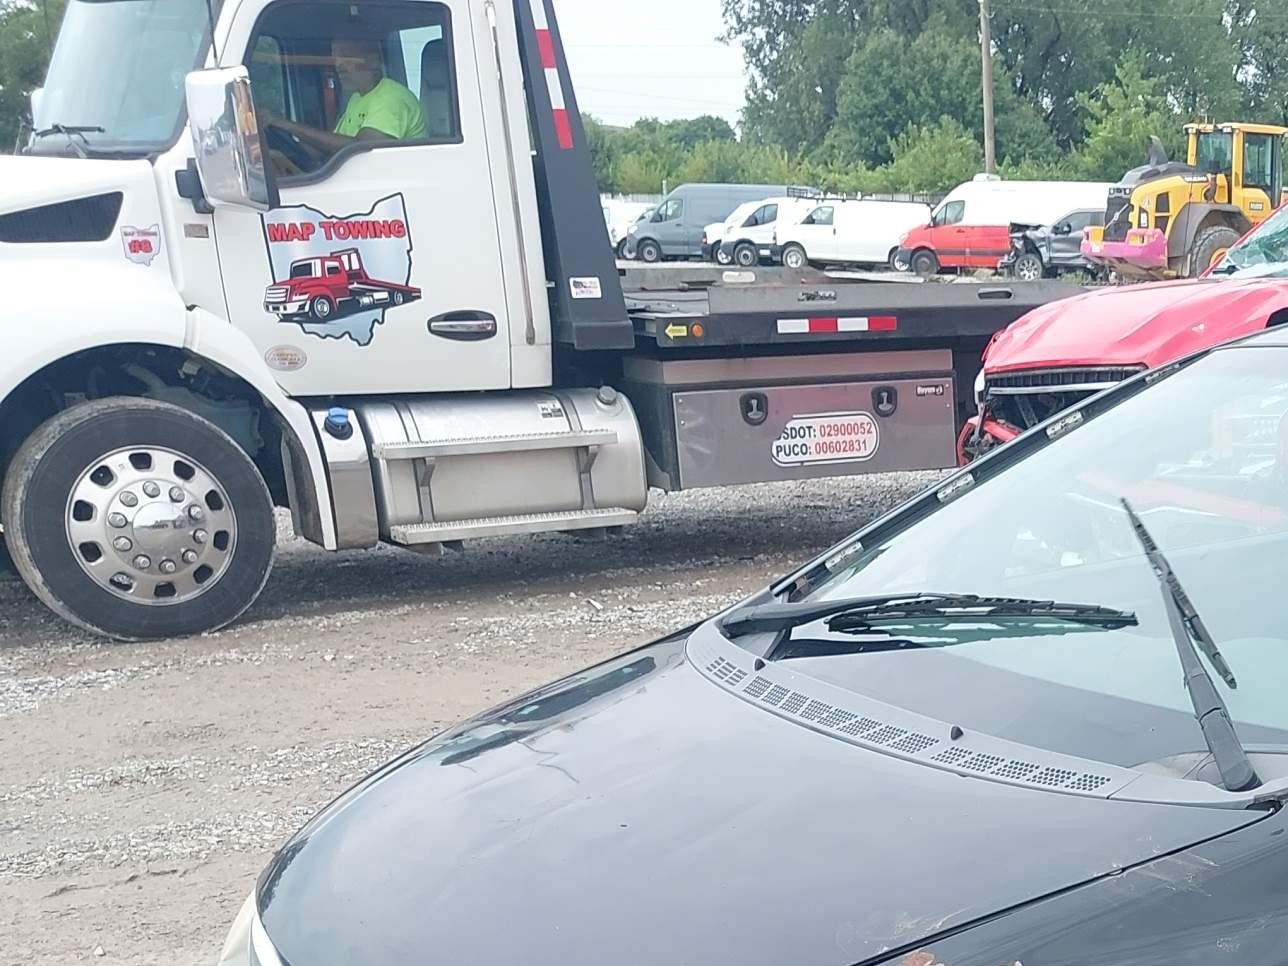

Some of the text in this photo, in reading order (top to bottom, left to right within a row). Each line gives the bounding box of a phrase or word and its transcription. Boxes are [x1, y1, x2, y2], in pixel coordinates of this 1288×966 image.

[267, 219, 406, 242] MAP TOWING
[777, 422, 873, 440] SDOT: 02900052
[775, 439, 868, 457] PUCO: 00602831
